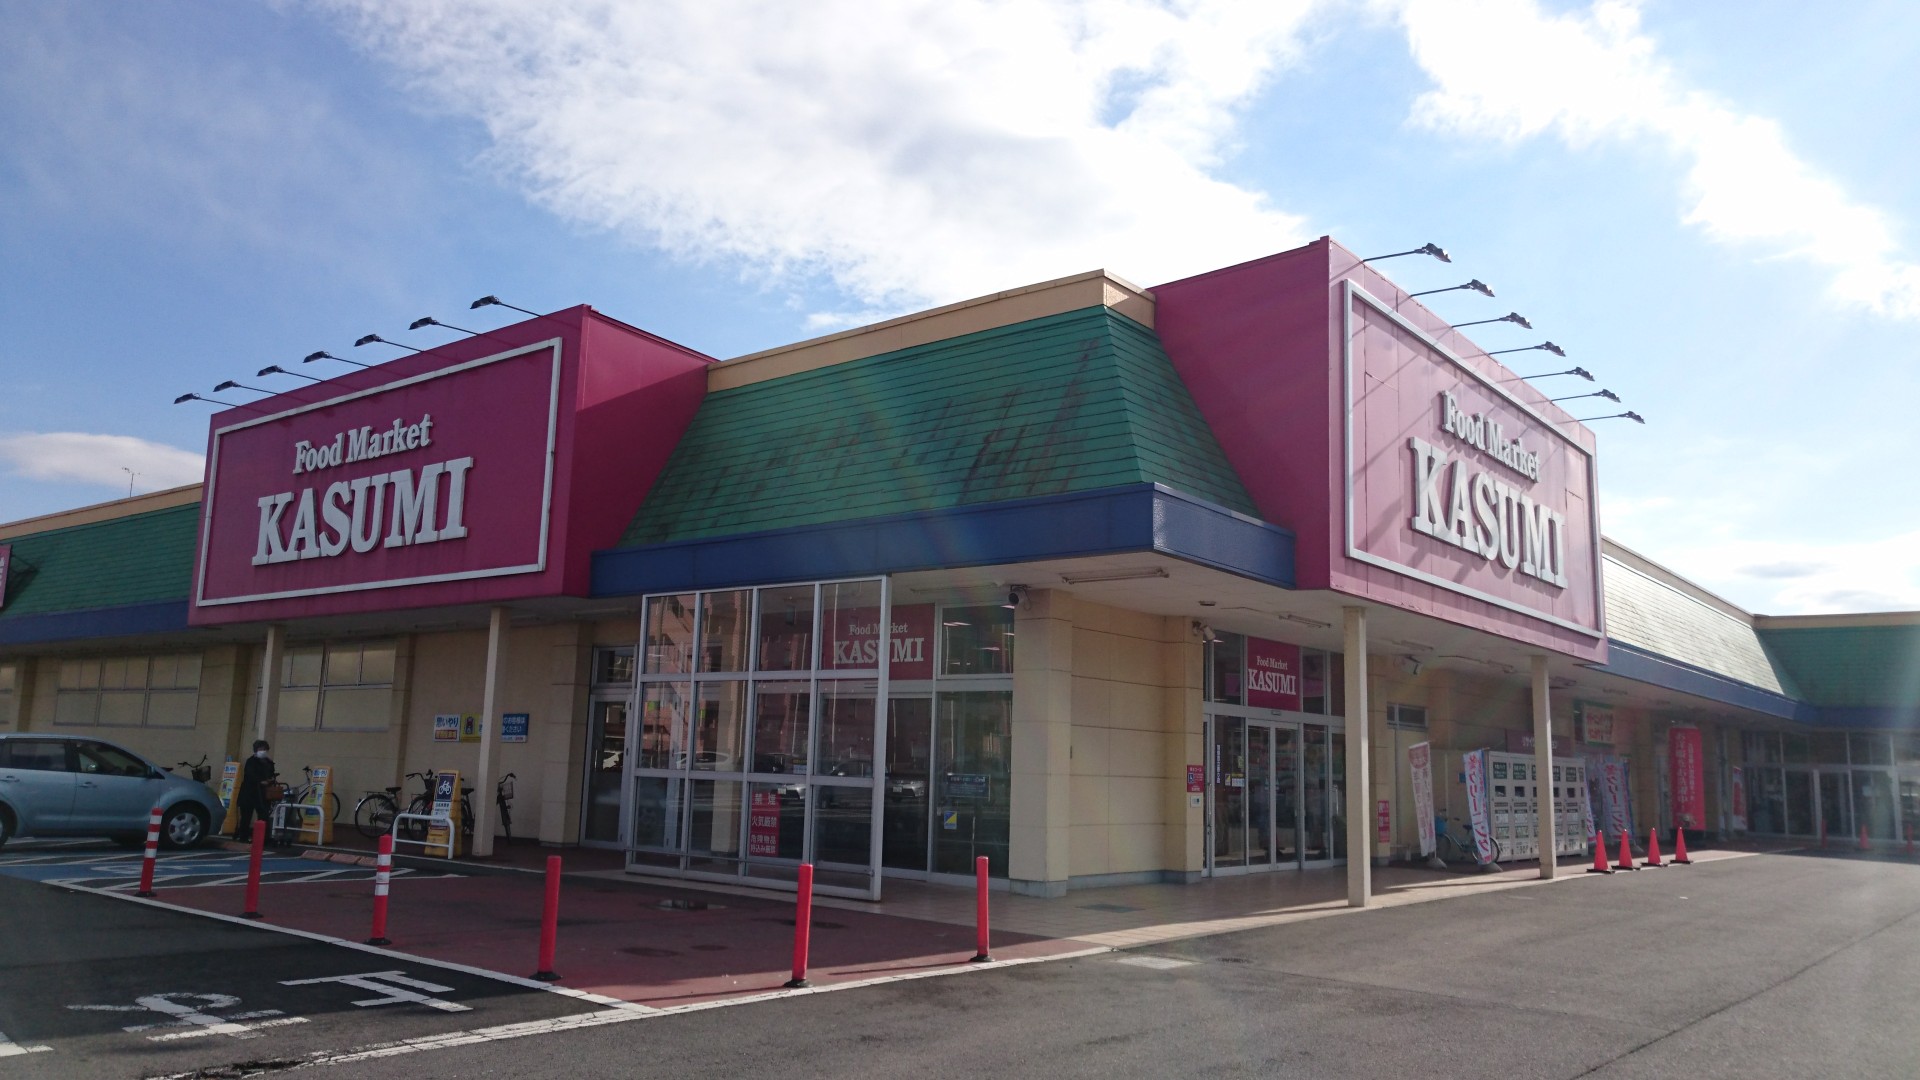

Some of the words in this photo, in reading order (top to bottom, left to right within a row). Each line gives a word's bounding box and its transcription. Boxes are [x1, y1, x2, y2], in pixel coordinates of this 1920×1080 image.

[293, 432, 344, 475] Food
[345, 413, 433, 463] Market
[1441, 389, 1485, 451] Food
[1485, 418, 1540, 483] Market
[251, 456, 474, 566] KASUMI
[1409, 436, 1568, 589] KASUMI
[848, 624, 871, 636] Food
[873, 622, 908, 635] Mket
[833, 637, 924, 665] KASMI
[1256, 655, 1269, 667] Food
[1270, 657, 1288, 670] Market
[1248, 668, 1296, 695] KASUMI
[752, 815, 777, 828] 火気厳禁
